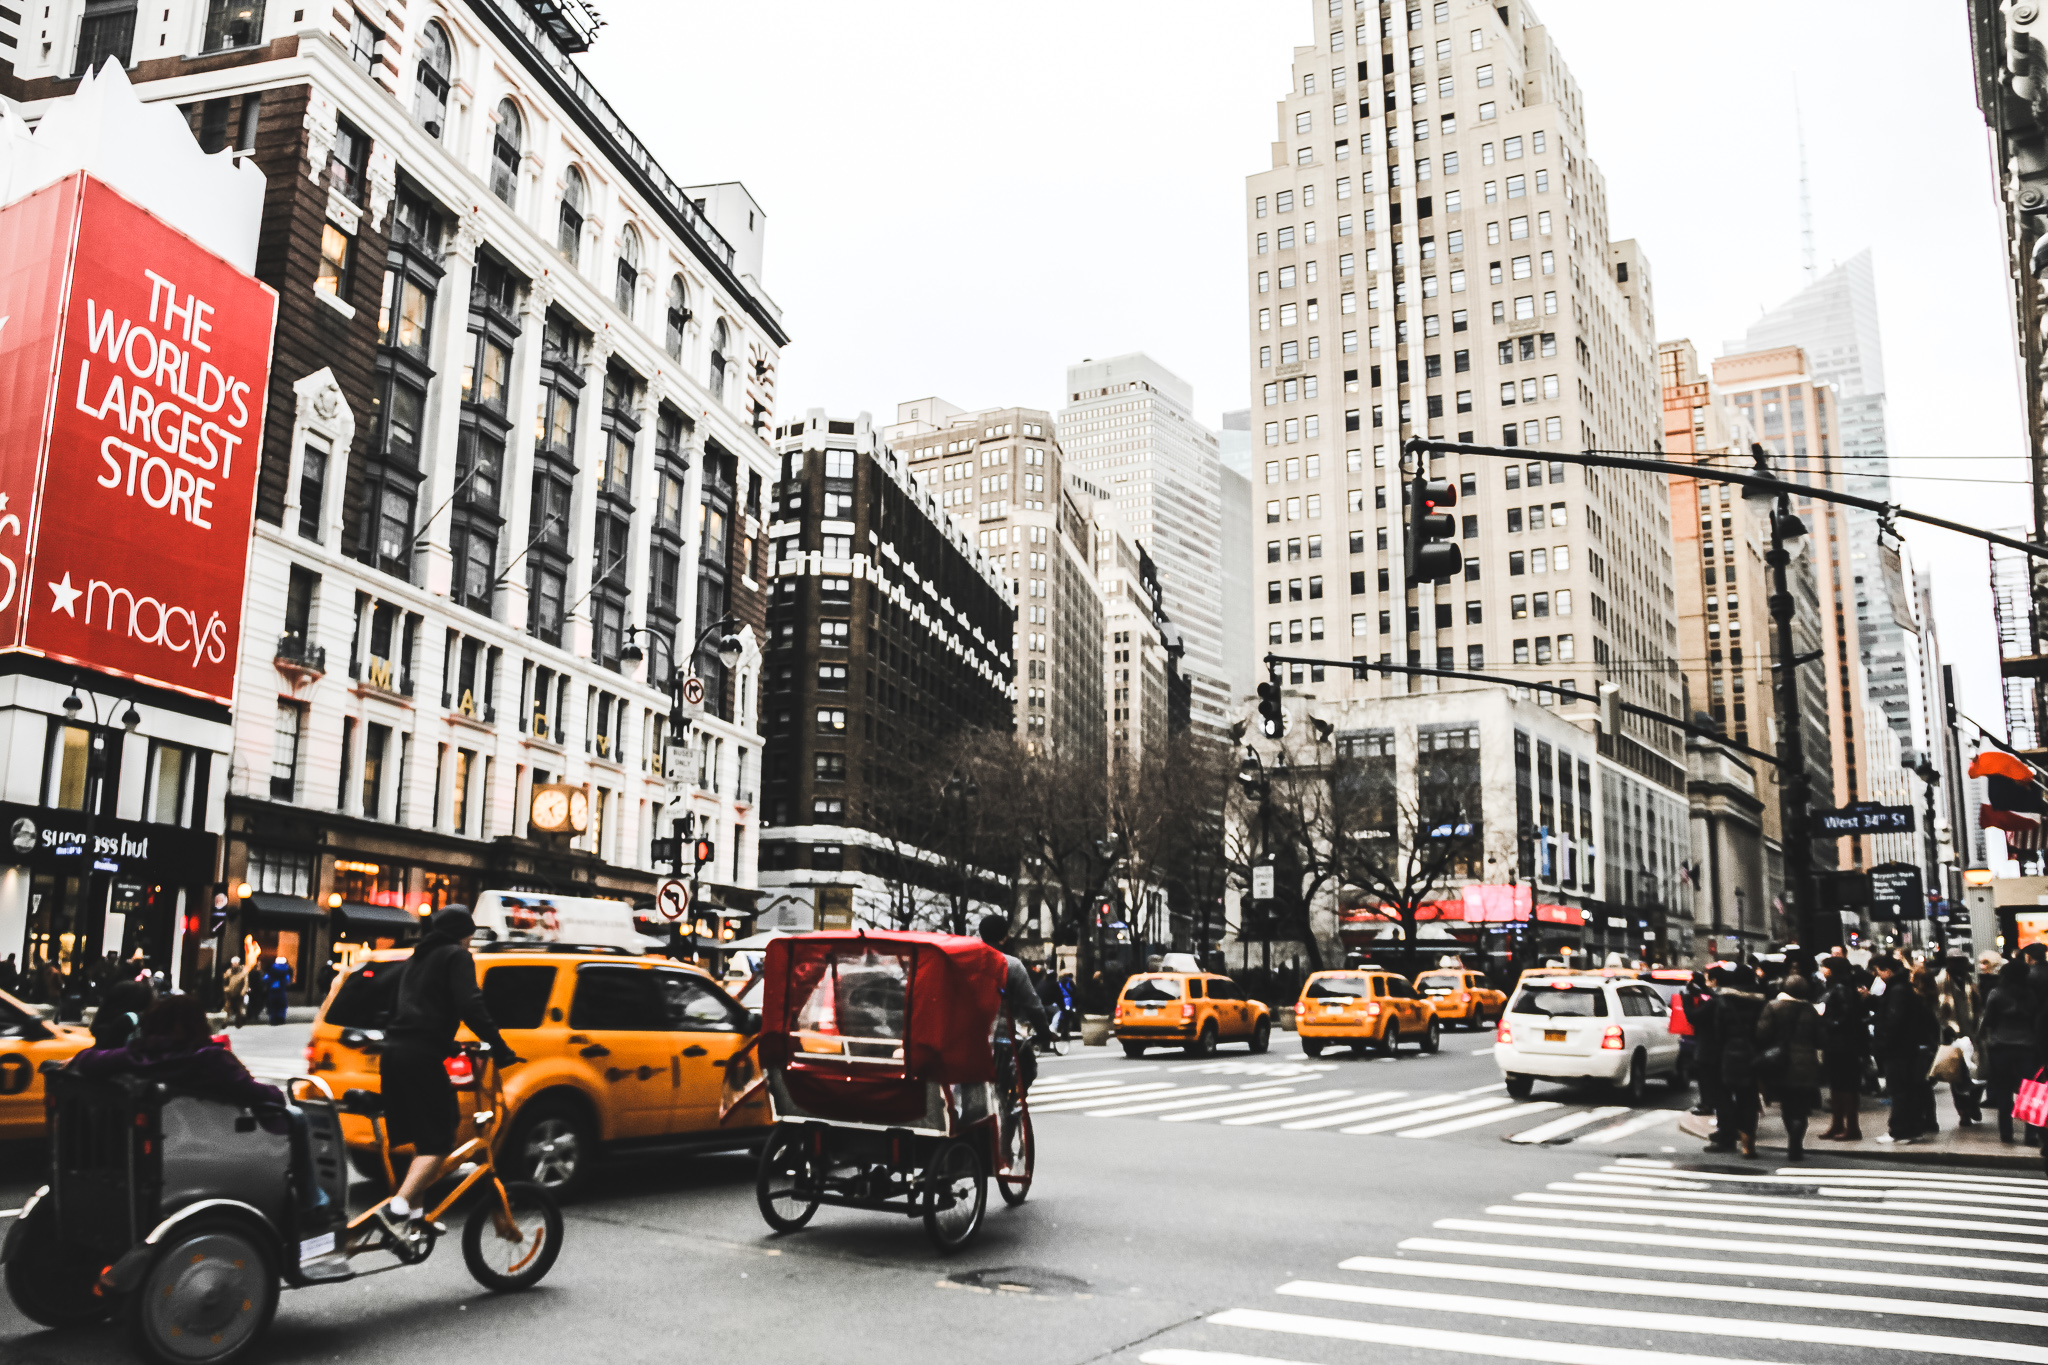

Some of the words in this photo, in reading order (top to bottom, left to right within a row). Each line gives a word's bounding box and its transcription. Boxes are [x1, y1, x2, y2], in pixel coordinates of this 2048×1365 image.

[145, 268, 215, 353] THE
[86, 298, 250, 428] WORLD'S
[76, 359, 242, 479] LARGEST
[97, 436, 216, 529] STORE
[85, 579, 227, 668] macy's
[121, 832, 148, 859] hut
[1824, 816, 1859, 828] West
[1891, 812, 1906, 827] St
